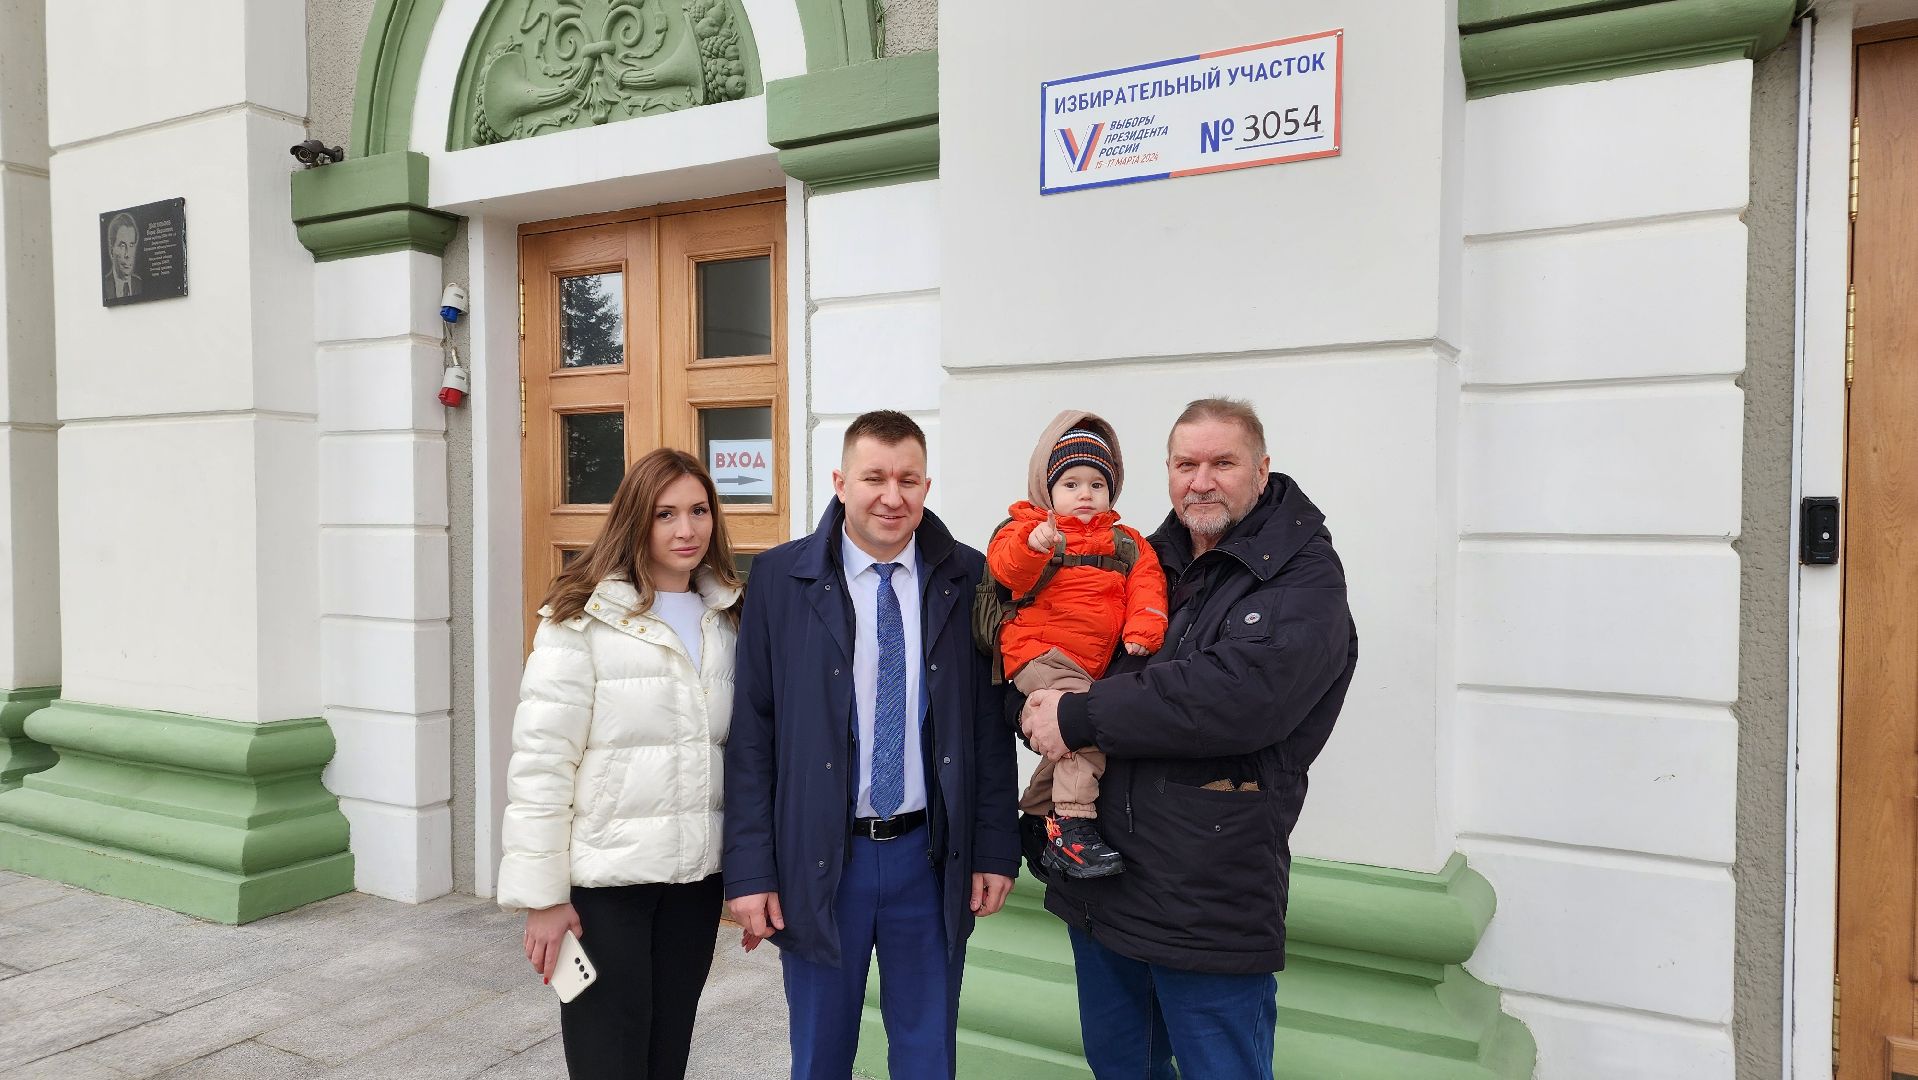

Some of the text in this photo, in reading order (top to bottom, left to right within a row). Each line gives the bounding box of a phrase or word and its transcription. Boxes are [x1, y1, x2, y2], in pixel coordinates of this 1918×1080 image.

[1054, 51, 1325, 115] ИЗБИРАТЕЛЬНЫЙ УЧАСТОК
[1110, 115, 1155, 131] ВЫБОРЫ
[1200, 104, 1322, 154] № 3054
[1104, 126, 1169, 145] ПРЕЗИДЕНТА
[1099, 143, 1140, 158] РОССИИ
[1115, 155, 1140, 167] МАРТА
[715, 451, 766, 469] ВХОД
